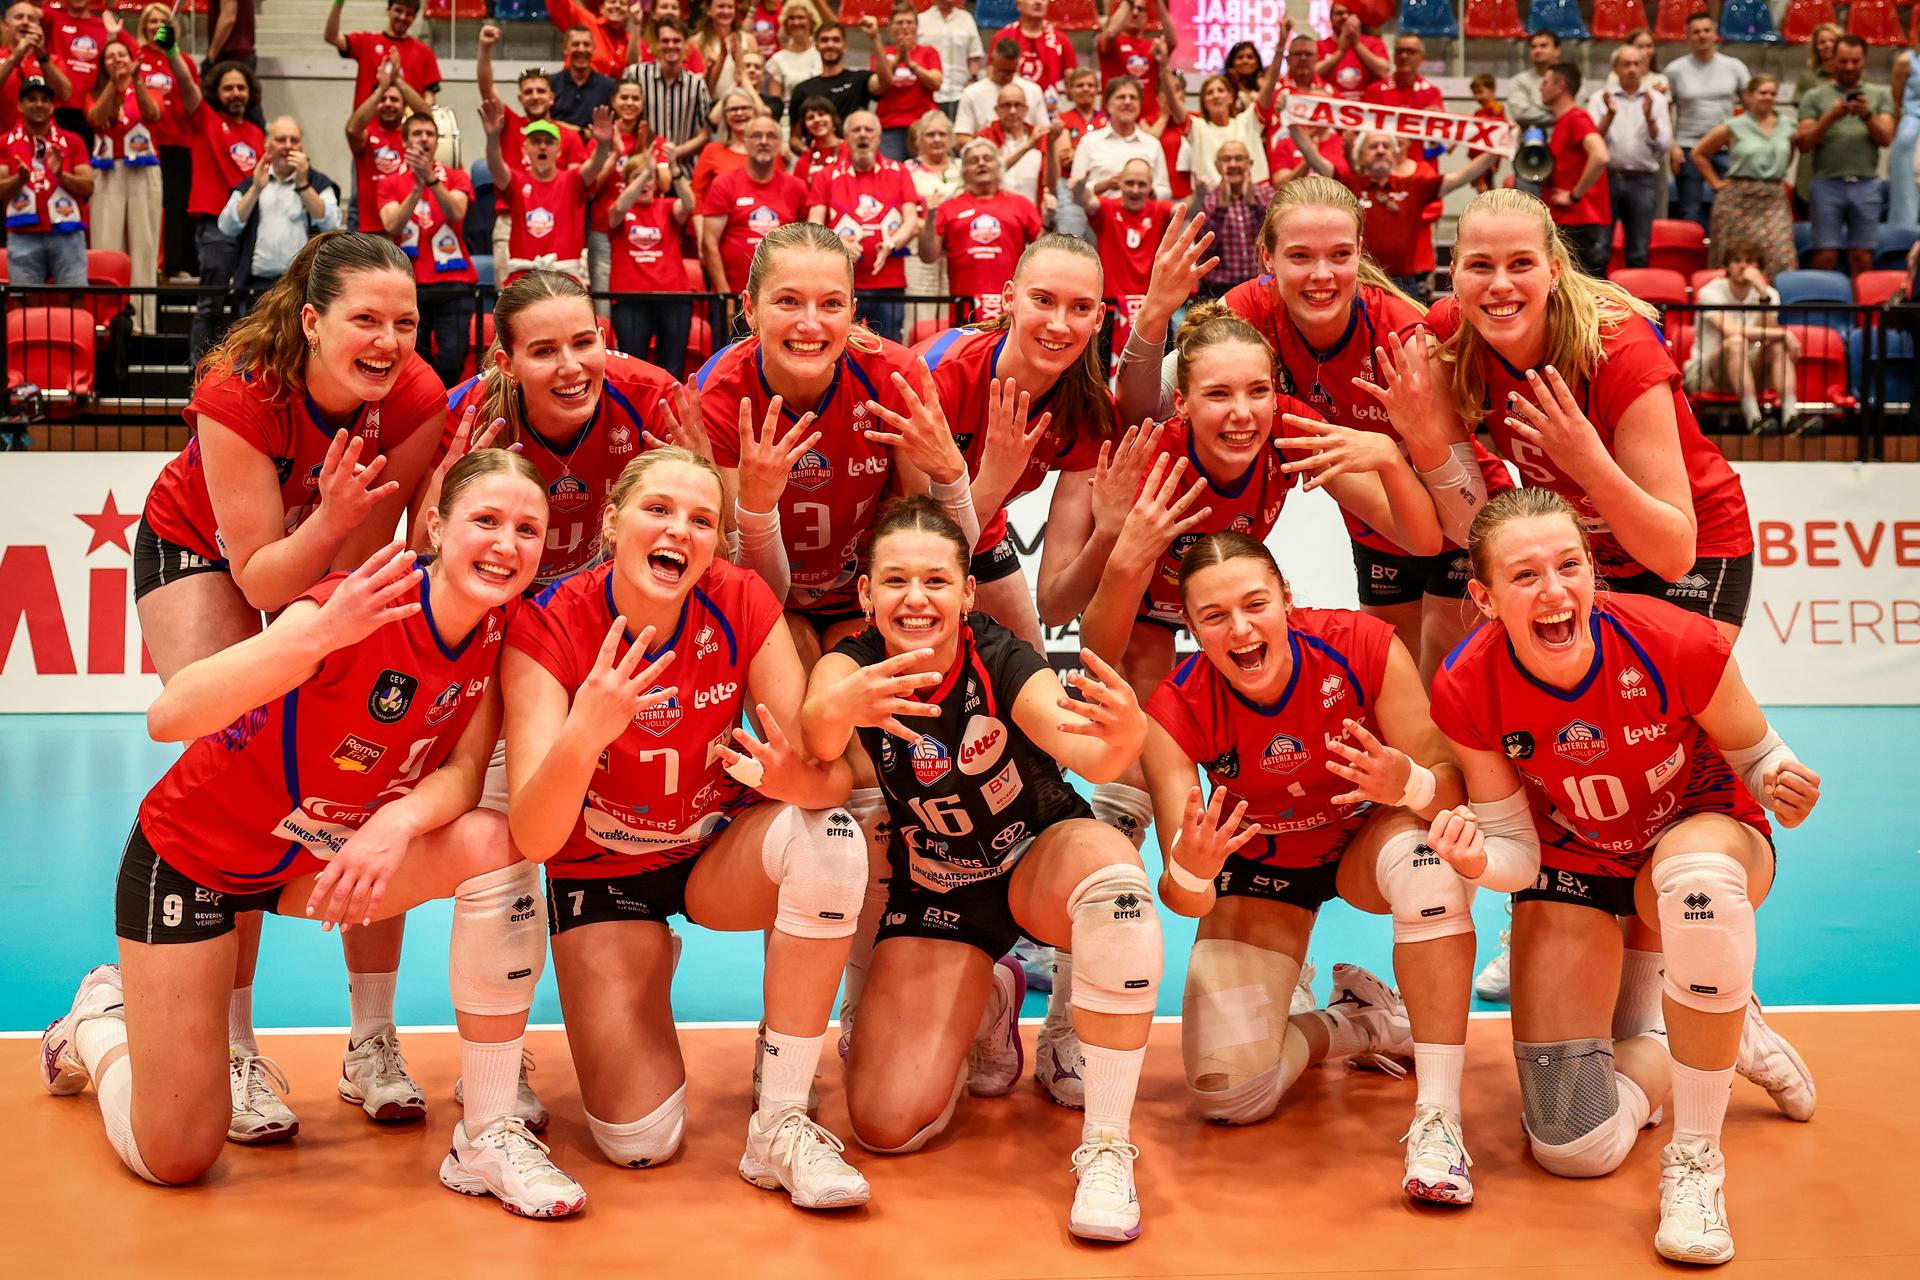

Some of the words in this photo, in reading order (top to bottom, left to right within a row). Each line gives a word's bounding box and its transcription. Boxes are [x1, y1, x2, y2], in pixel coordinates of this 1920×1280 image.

[1310, 102, 1500, 147] ASTERIX
[609, 442, 633, 455] errea
[1511, 437, 1556, 482] 5
[788, 468, 816, 479] ASTERIX
[818, 467, 831, 478] AVO
[848, 456, 888, 477] Lotto
[551, 492, 574, 503] STERIX
[793, 501, 831, 551] 3
[1180, 535, 1198, 543] CEV
[1666, 588, 1708, 599] errea
[389, 674, 407, 685] CEV
[694, 682, 738, 709] Lotto
[635, 710, 665, 720] ASTERIX
[666, 709, 680, 718] AVO
[1505, 734, 1520, 743] EV
[345, 738, 380, 758] Remo
[961, 729, 1001, 764] Lotto
[1557, 740, 1588, 752] ASTERIX
[1591, 739, 1606, 749] AVO
[912, 760, 933, 769] TERIX
[935, 760, 949, 768] AVO
[1263, 754, 1292, 766] ASTERIX
[1294, 751, 1307, 760] AVO
[640, 748, 679, 795] 7
[1562, 774, 1630, 821] 10
[688, 790, 720, 821] TOYOTA
[332, 811, 371, 823] PIET
[613, 809, 677, 830] PIETERS
[908, 794, 974, 837] 16
[827, 828, 854, 838] errea
[1413, 856, 1441, 868] errea
[567, 890, 585, 916] 7
[162, 894, 183, 927] 9
[510, 909, 536, 922] errea
[1114, 909, 1141, 920] errea
[1684, 910, 1715, 921] errea
